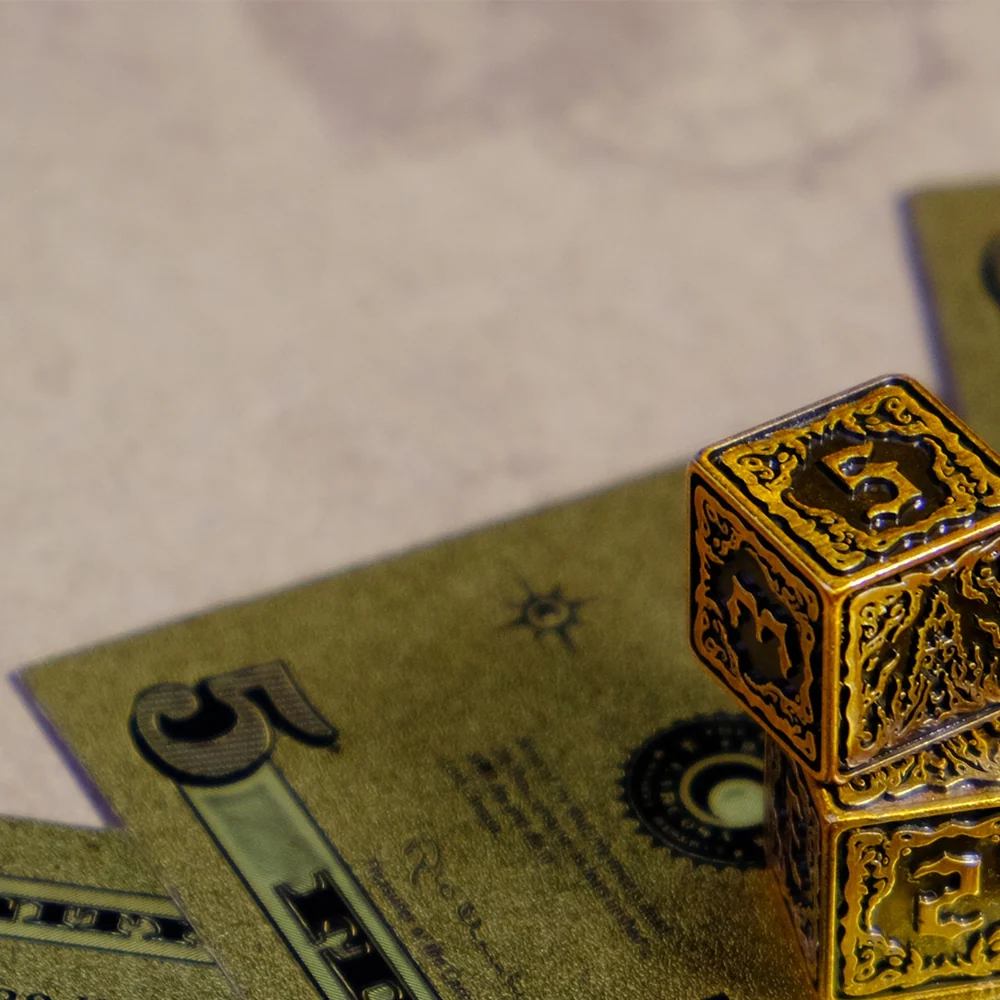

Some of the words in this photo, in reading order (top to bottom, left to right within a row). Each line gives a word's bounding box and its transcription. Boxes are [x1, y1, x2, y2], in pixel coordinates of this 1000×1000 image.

[820, 438, 924, 530] 5
[130, 659, 339, 787] 5
[910, 850, 985, 944] 2
